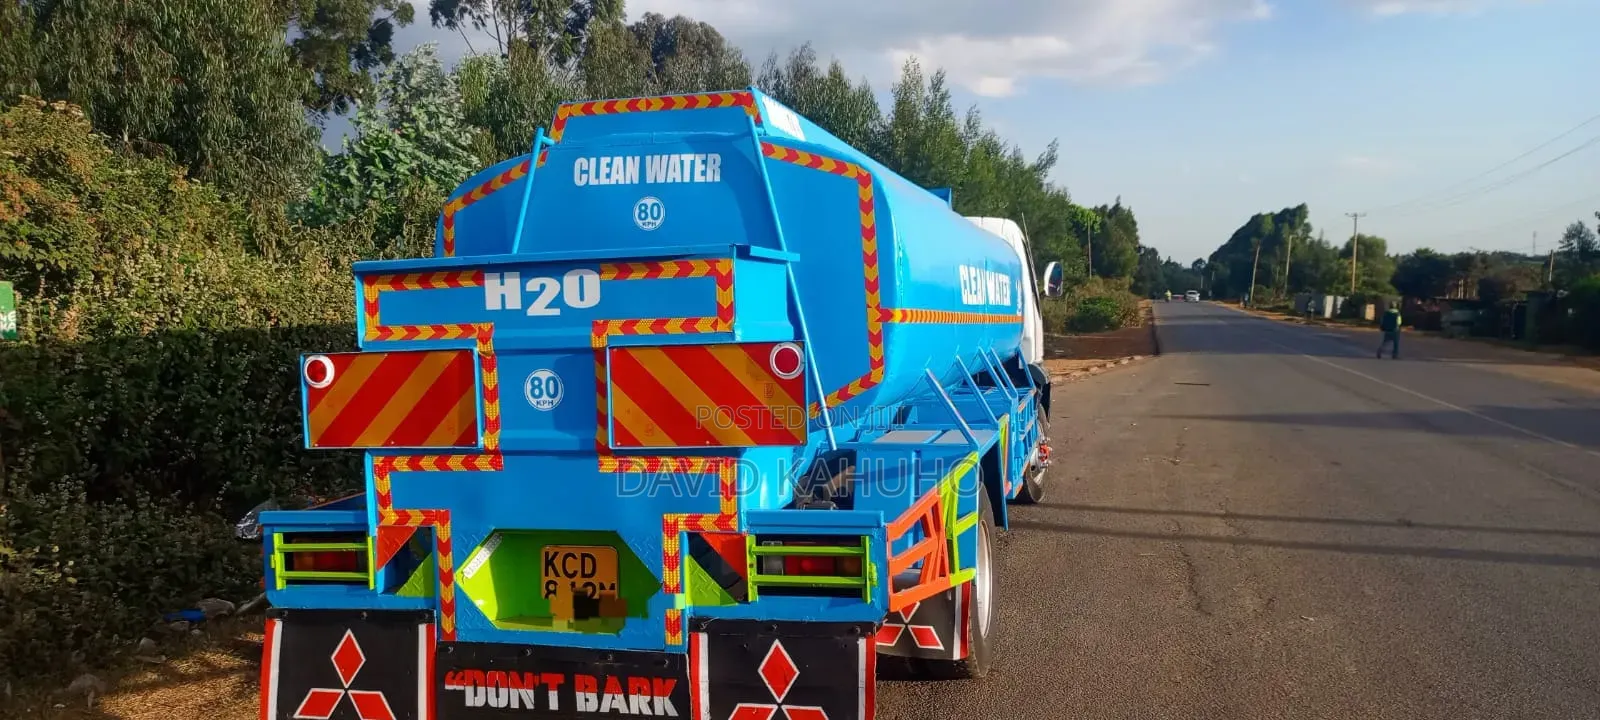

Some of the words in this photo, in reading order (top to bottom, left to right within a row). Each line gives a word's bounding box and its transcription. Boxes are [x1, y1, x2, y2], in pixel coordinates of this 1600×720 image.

[574, 156, 640, 186] CLEAN
[645, 153, 722, 184] WATER
[637, 203, 662, 221] 80
[484, 269, 601, 316] H2O
[959, 264, 986, 305] CLEAN
[529, 376, 560, 399] 80
[544, 552, 597, 579] KCD
[575, 675, 679, 717] BARK
